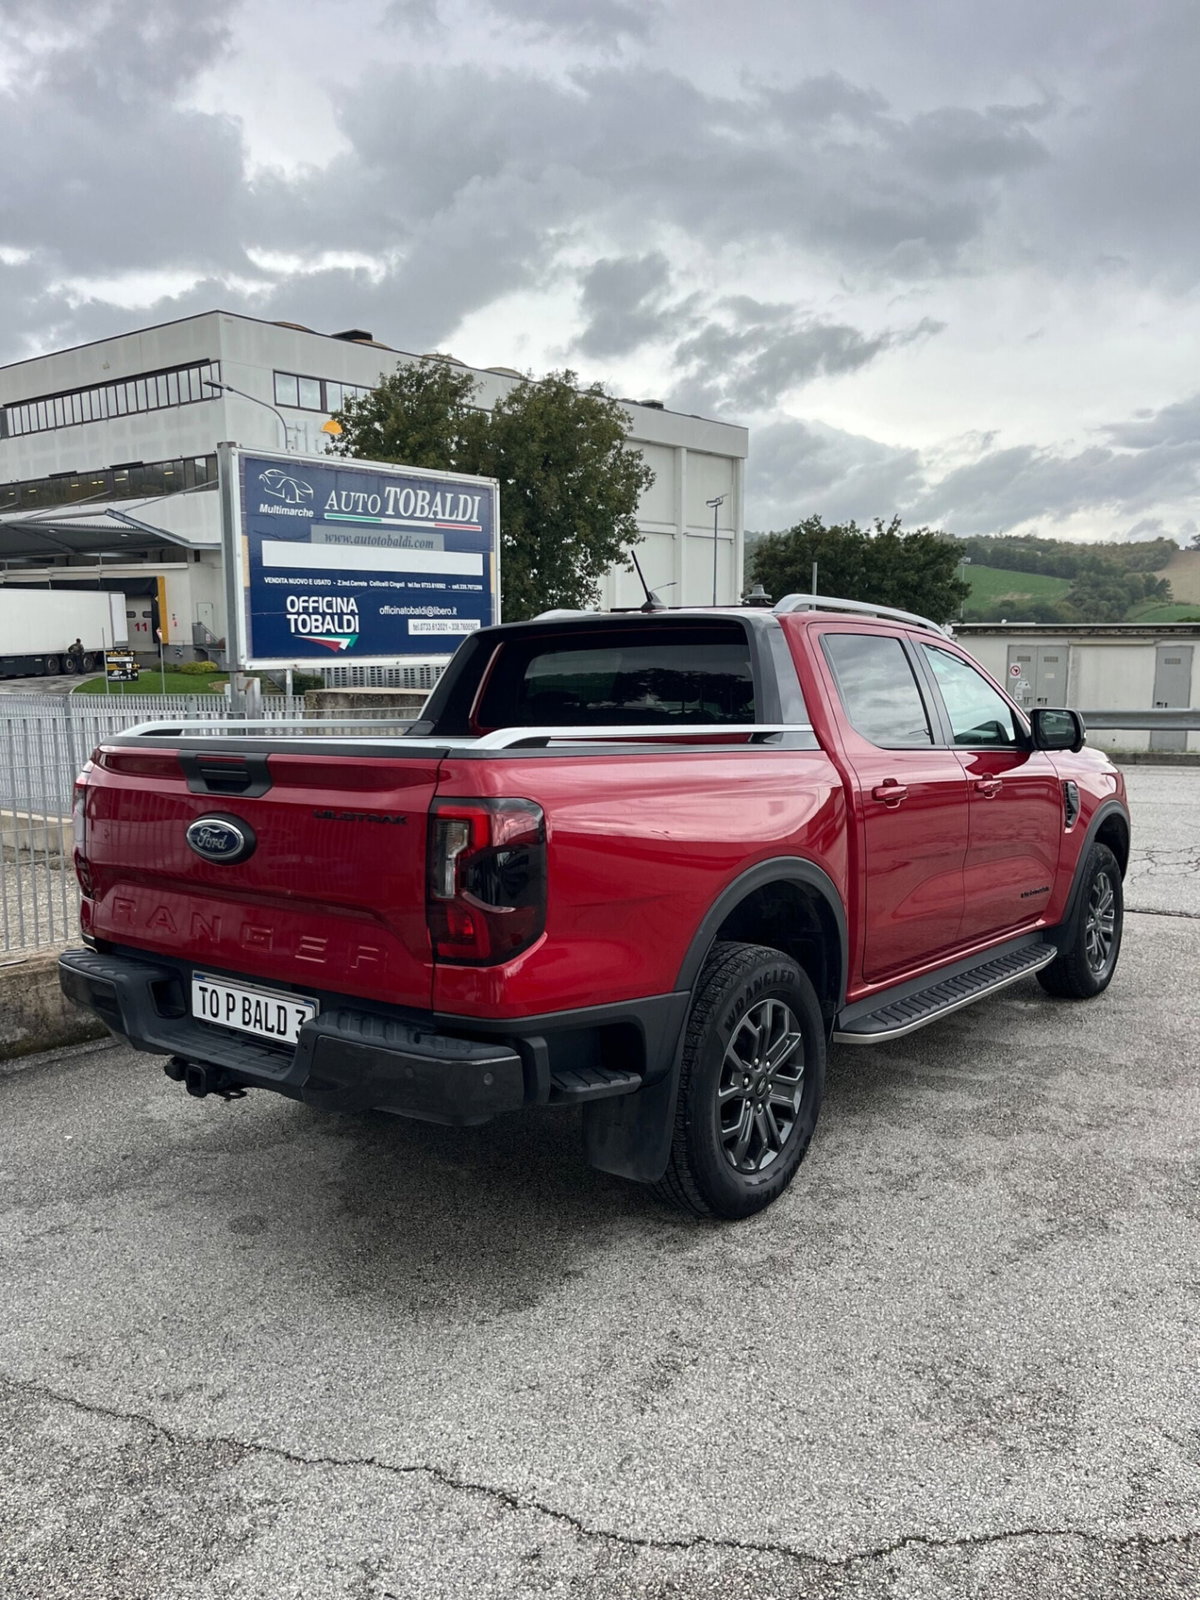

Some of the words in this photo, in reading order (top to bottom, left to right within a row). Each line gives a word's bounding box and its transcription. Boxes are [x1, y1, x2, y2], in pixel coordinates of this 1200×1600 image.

[259, 503, 314, 518] Multimarche
[324, 489, 381, 514] AUTO
[385, 486, 482, 522] TOBALDI
[324, 533, 434, 550] www.autotobaldi.com
[286, 595, 358, 614] OFFICINA
[379, 605, 457, 617] officinatobaldi@libero.it
[134, 622, 148, 632] 11
[286, 614, 360, 633] TOBALDI
[197, 827, 227, 849] Ford
[112, 896, 388, 974] RANGER
[199, 986, 219, 1018] TO
[226, 992, 236, 1022] P
[242, 996, 287, 1036] BALD
